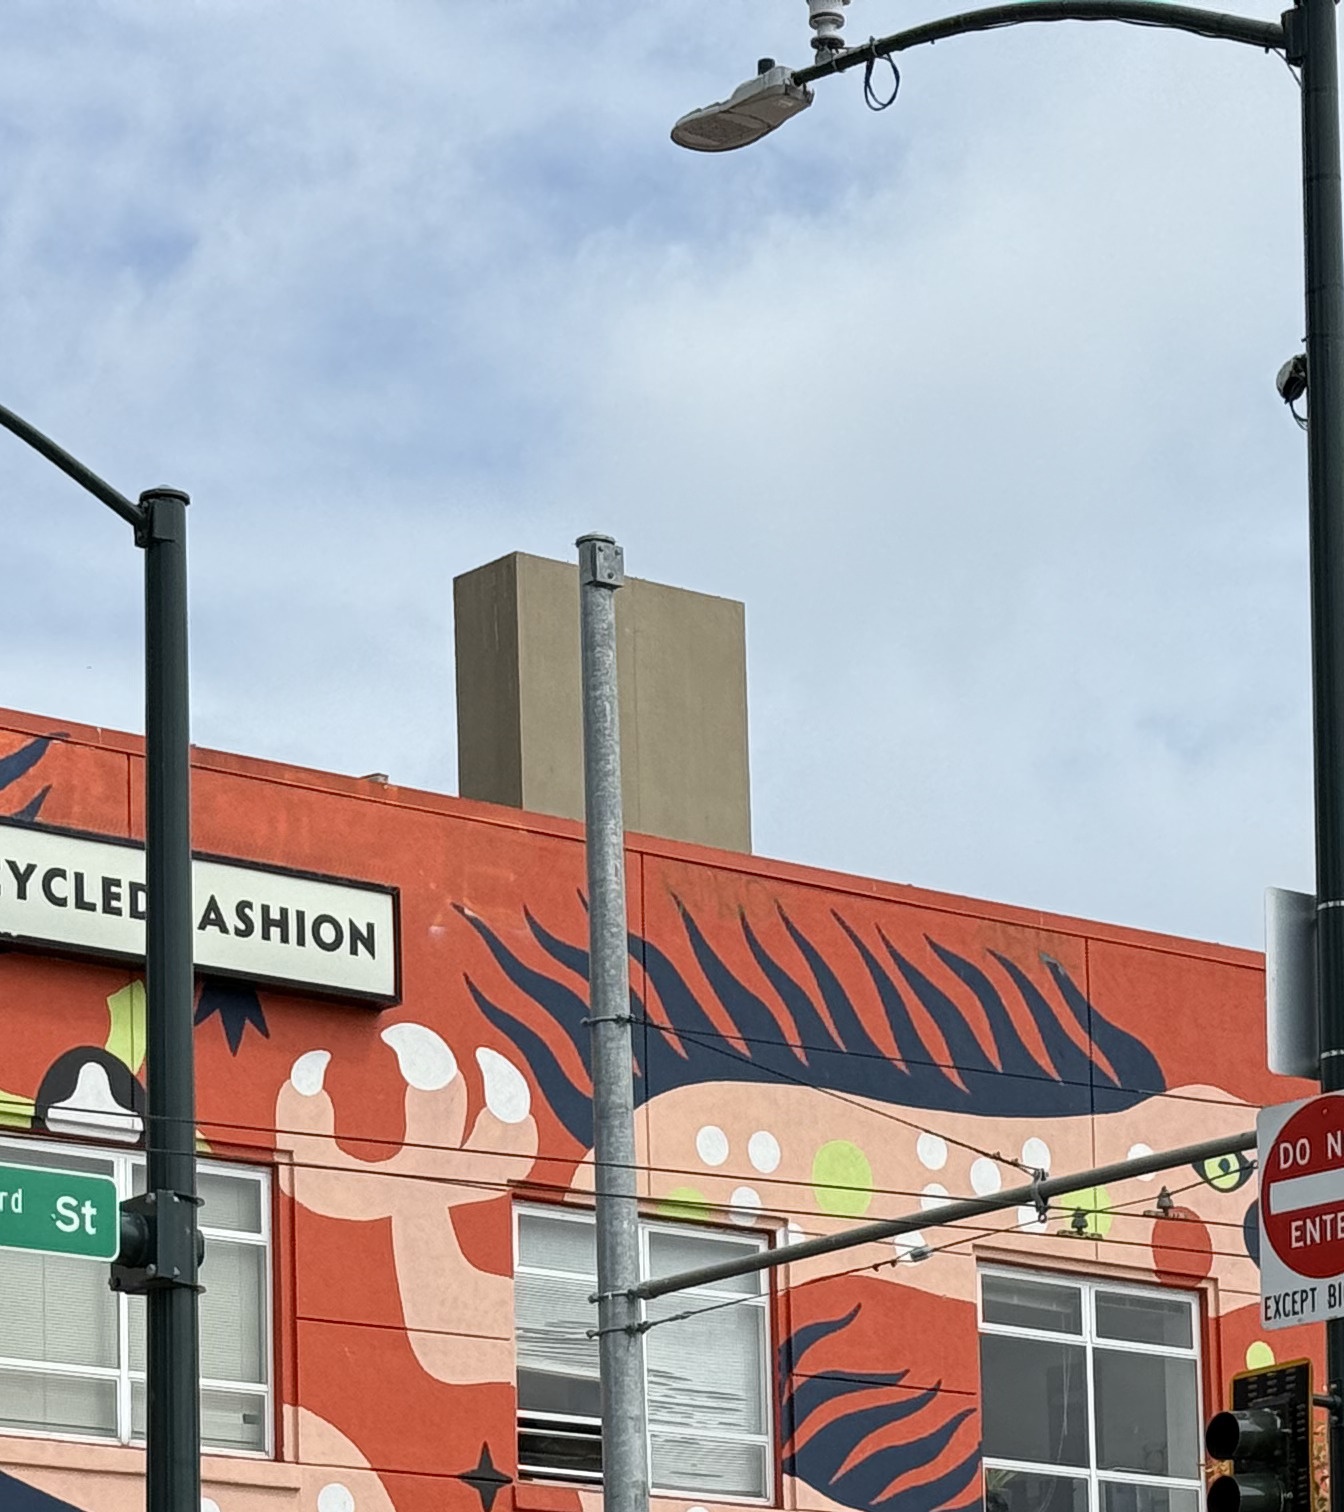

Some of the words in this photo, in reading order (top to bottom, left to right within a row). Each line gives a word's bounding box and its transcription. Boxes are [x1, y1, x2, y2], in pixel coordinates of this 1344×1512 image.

[197, 894, 377, 961] ASHION
[1279, 1138, 1310, 1170] DO
[55, 1196, 98, 1236] St
[1264, 1287, 1317, 1322] EXCEPT
